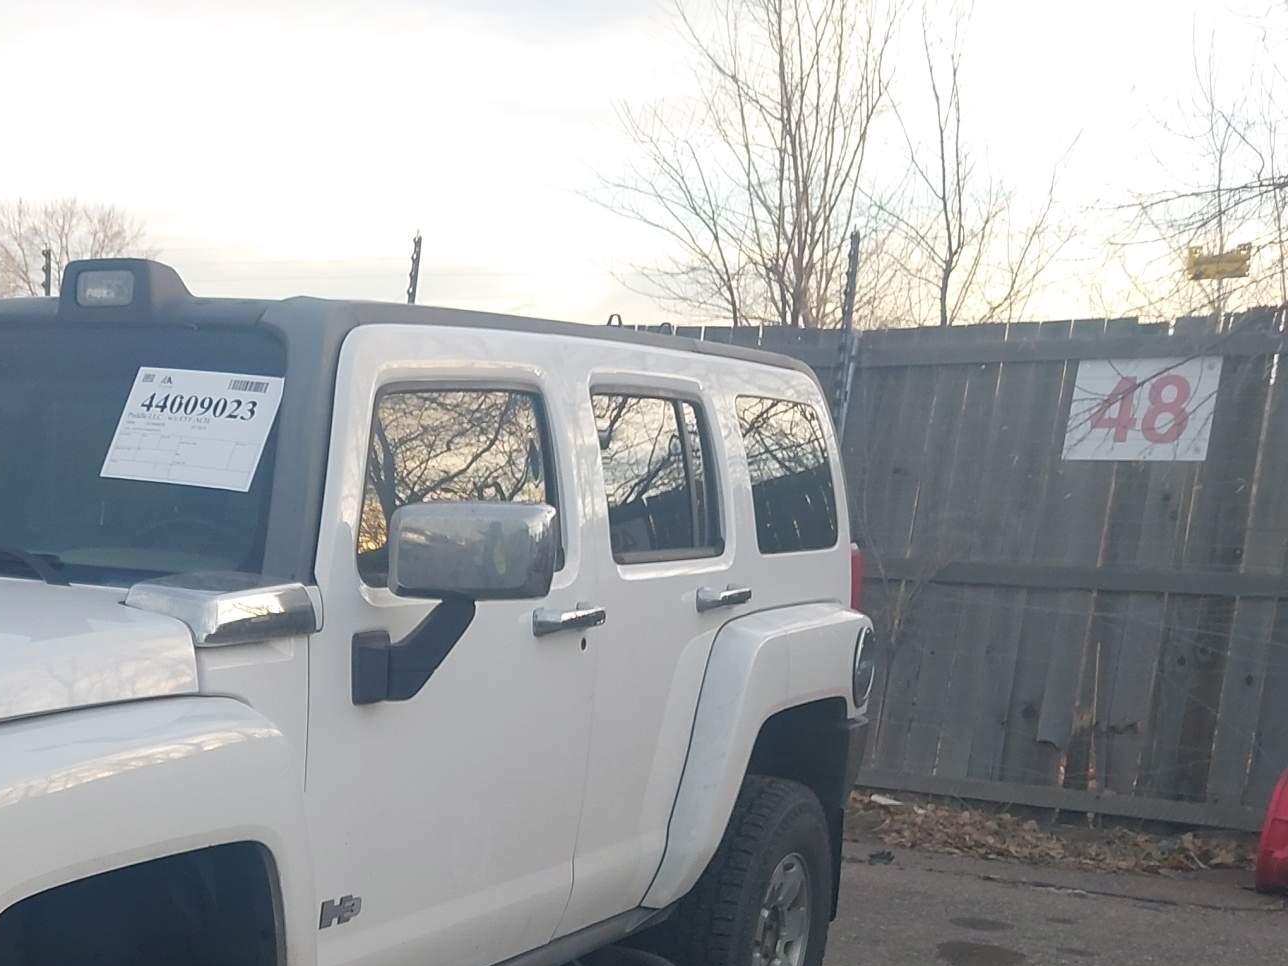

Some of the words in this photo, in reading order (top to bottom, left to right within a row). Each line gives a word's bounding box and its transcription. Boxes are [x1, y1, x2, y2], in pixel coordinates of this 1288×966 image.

[140, 392, 258, 421] 44009023
[1091, 373, 1192, 445] 48
[318, 894, 362, 931] H3
